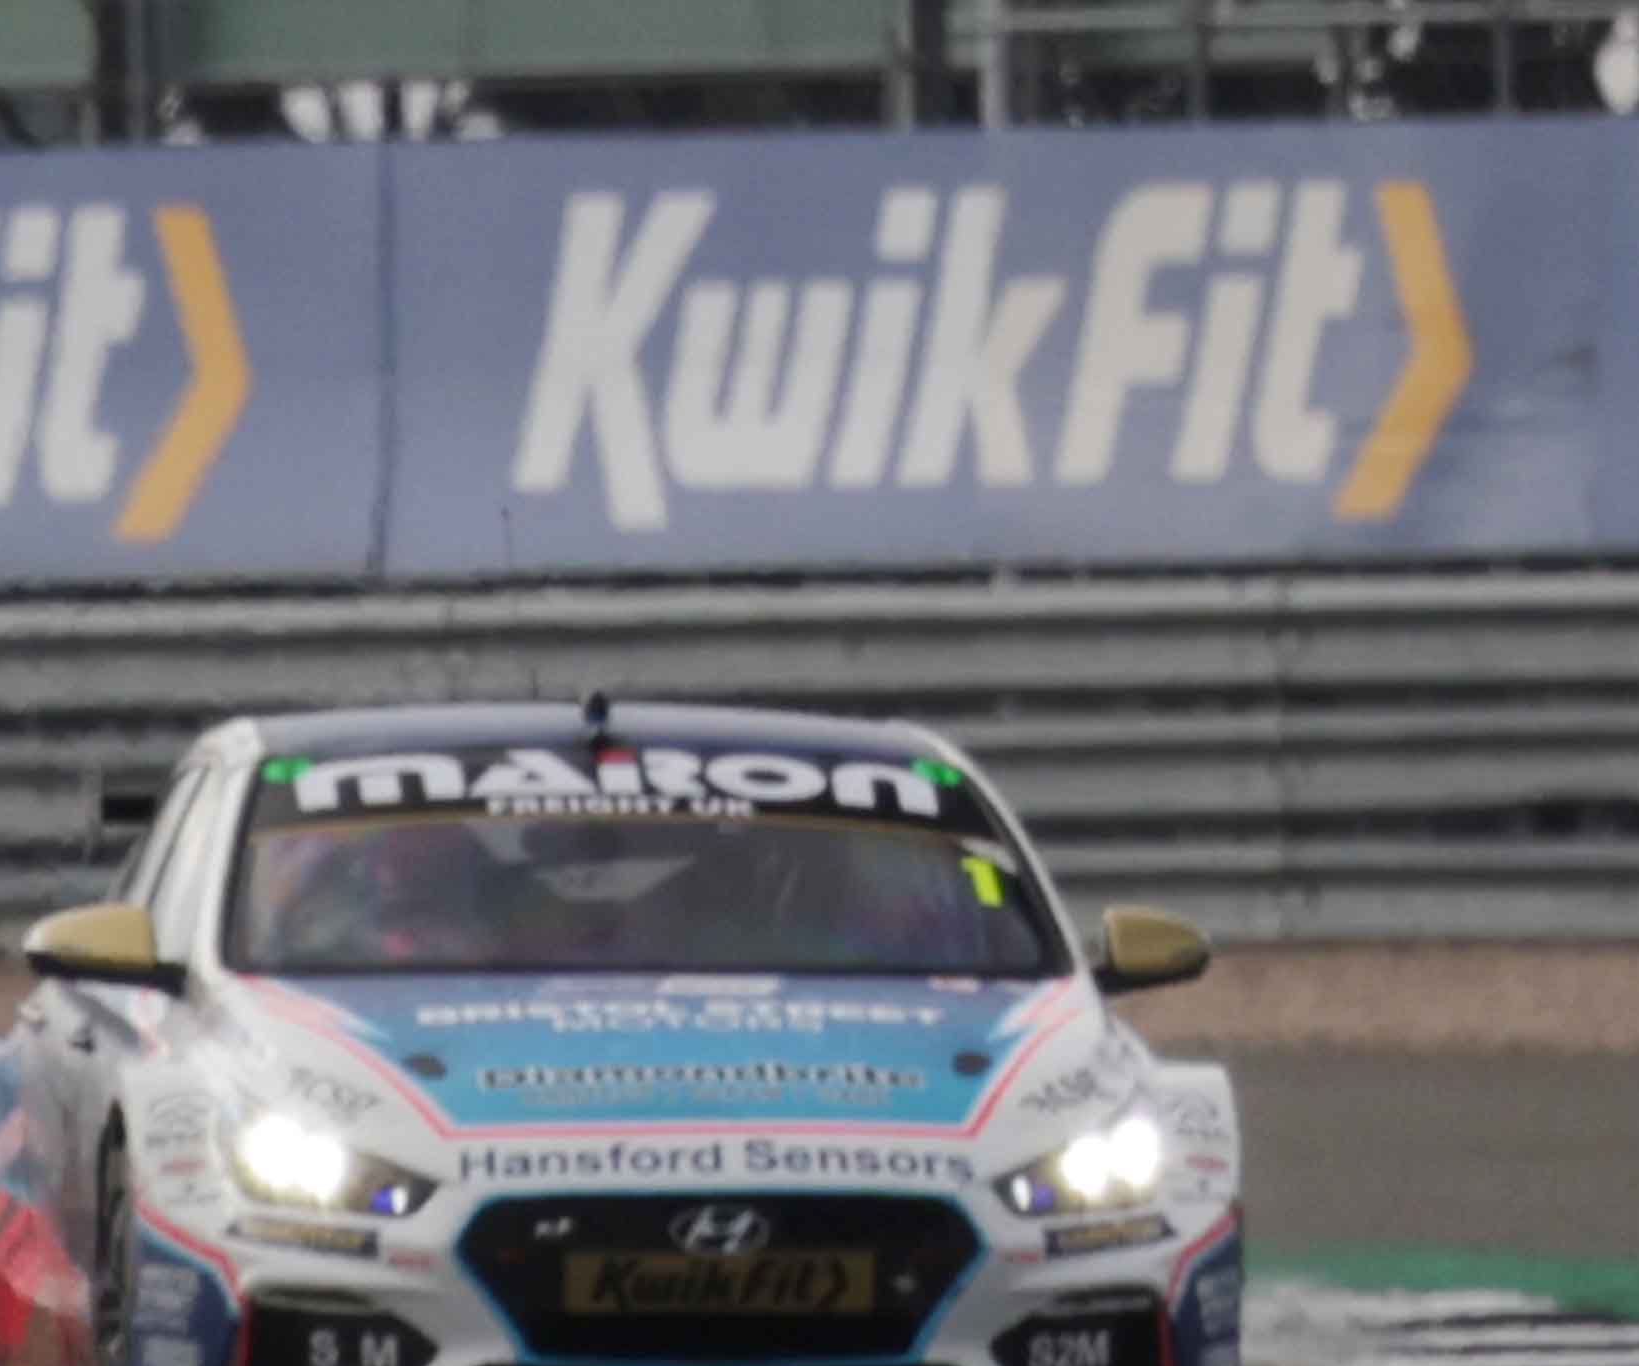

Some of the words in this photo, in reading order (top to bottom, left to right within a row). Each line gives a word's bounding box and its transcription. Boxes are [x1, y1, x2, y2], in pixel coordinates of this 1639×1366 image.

[510, 178, 1362, 531] KwikFit
[487, 798, 676, 817] FREIGHT
[958, 857, 1002, 907] 1
[460, 1143, 723, 1181] Hansford
[745, 1140, 974, 1182] Sensors
